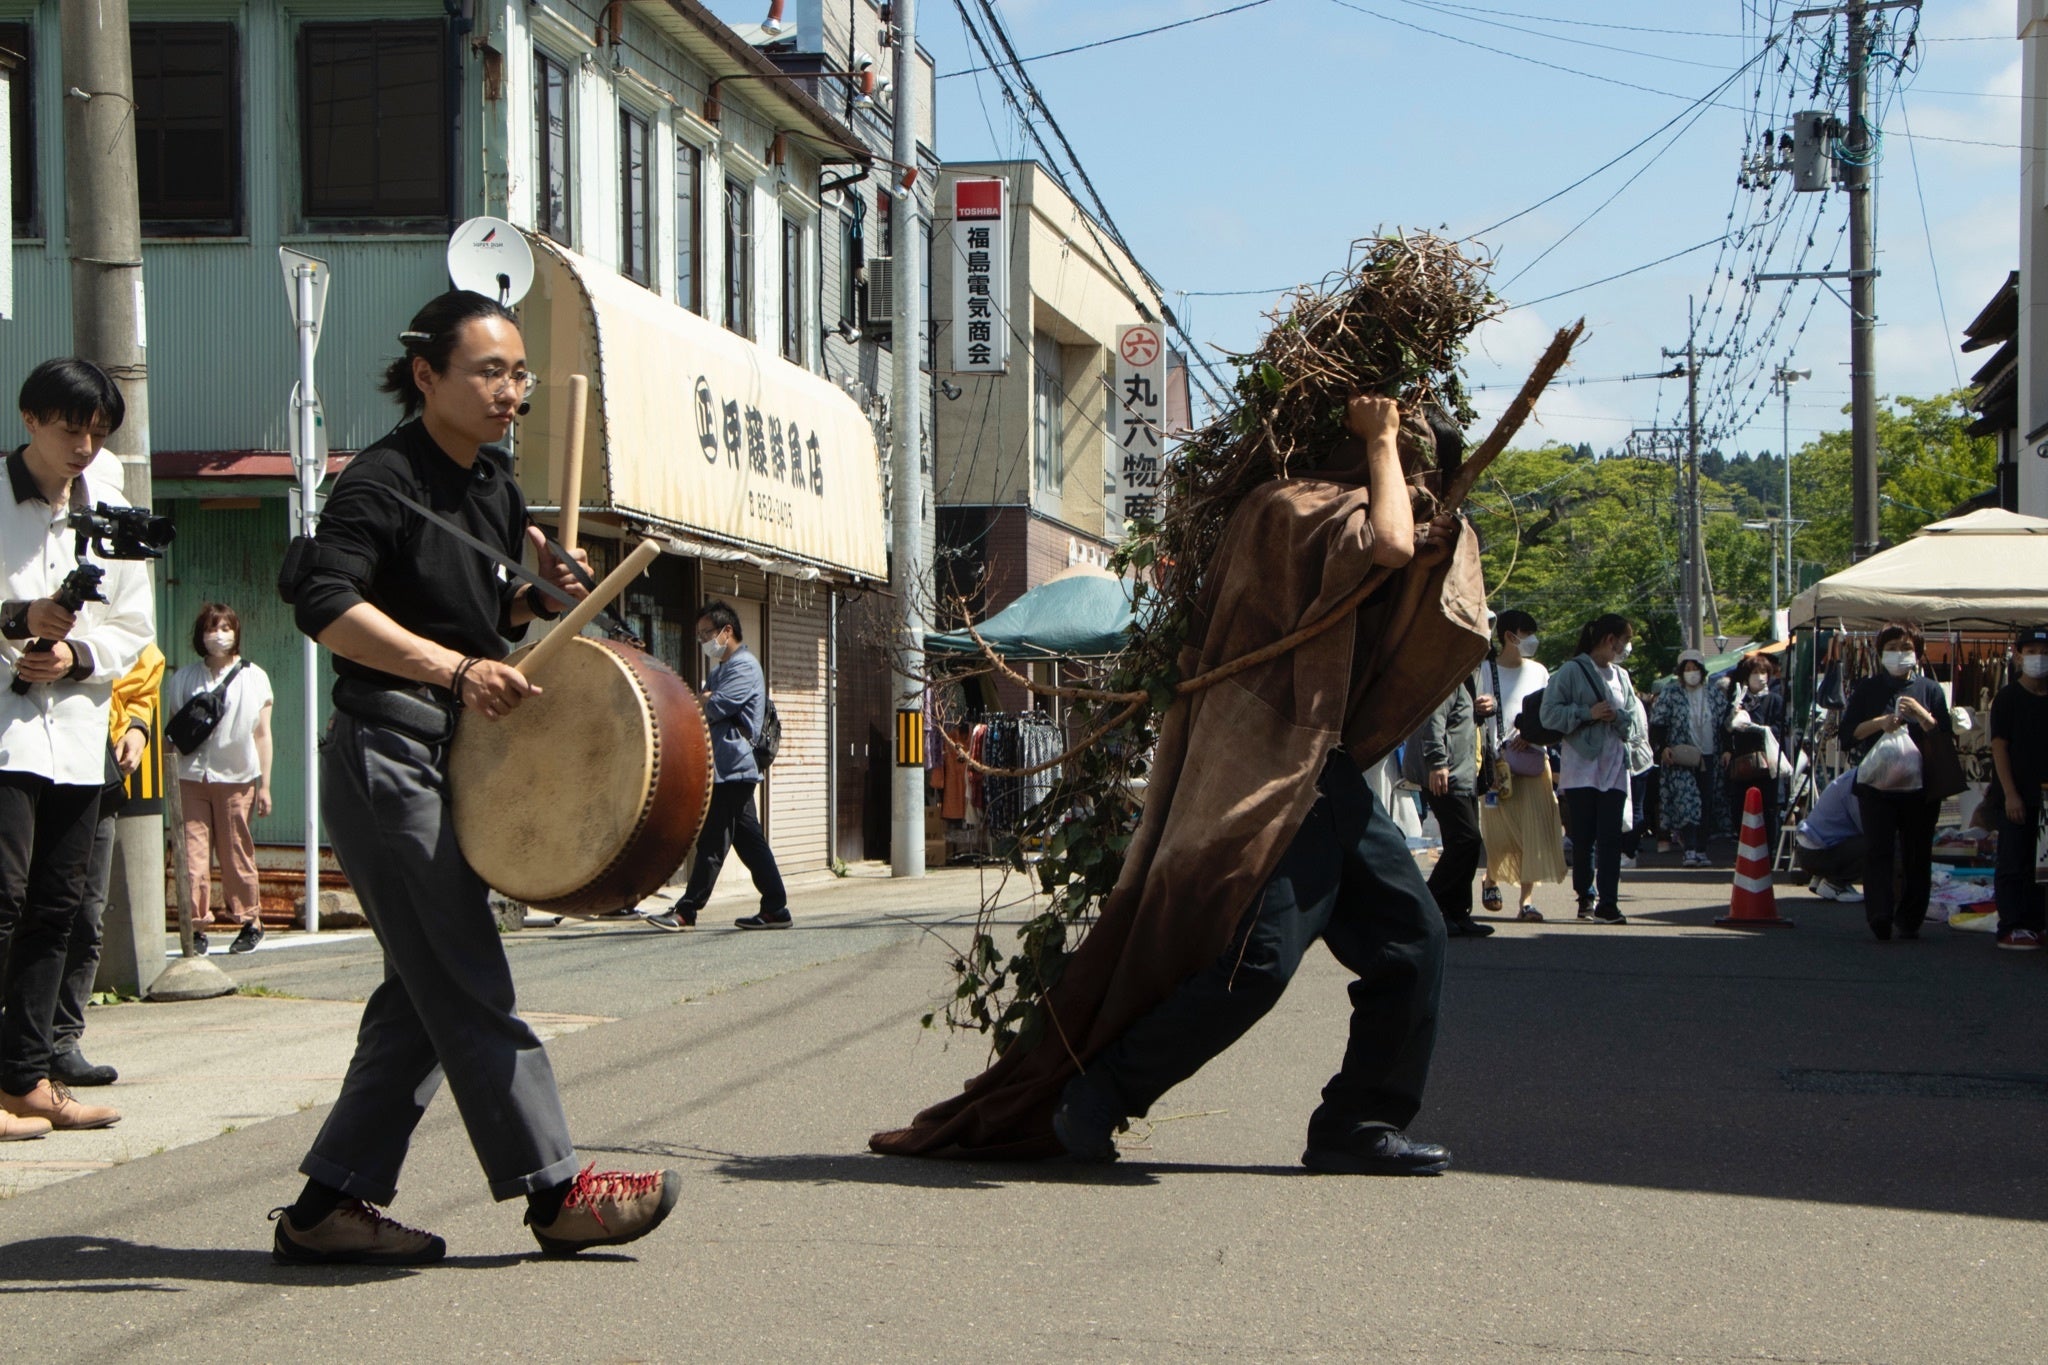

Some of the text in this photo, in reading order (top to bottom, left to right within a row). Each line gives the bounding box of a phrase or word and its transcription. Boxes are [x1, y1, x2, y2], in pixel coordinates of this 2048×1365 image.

[958, 207, 999, 217] TOSHIBA
[967, 226, 992, 366] 福島電気商会
[1484, 889, 1502, 901] Lee
